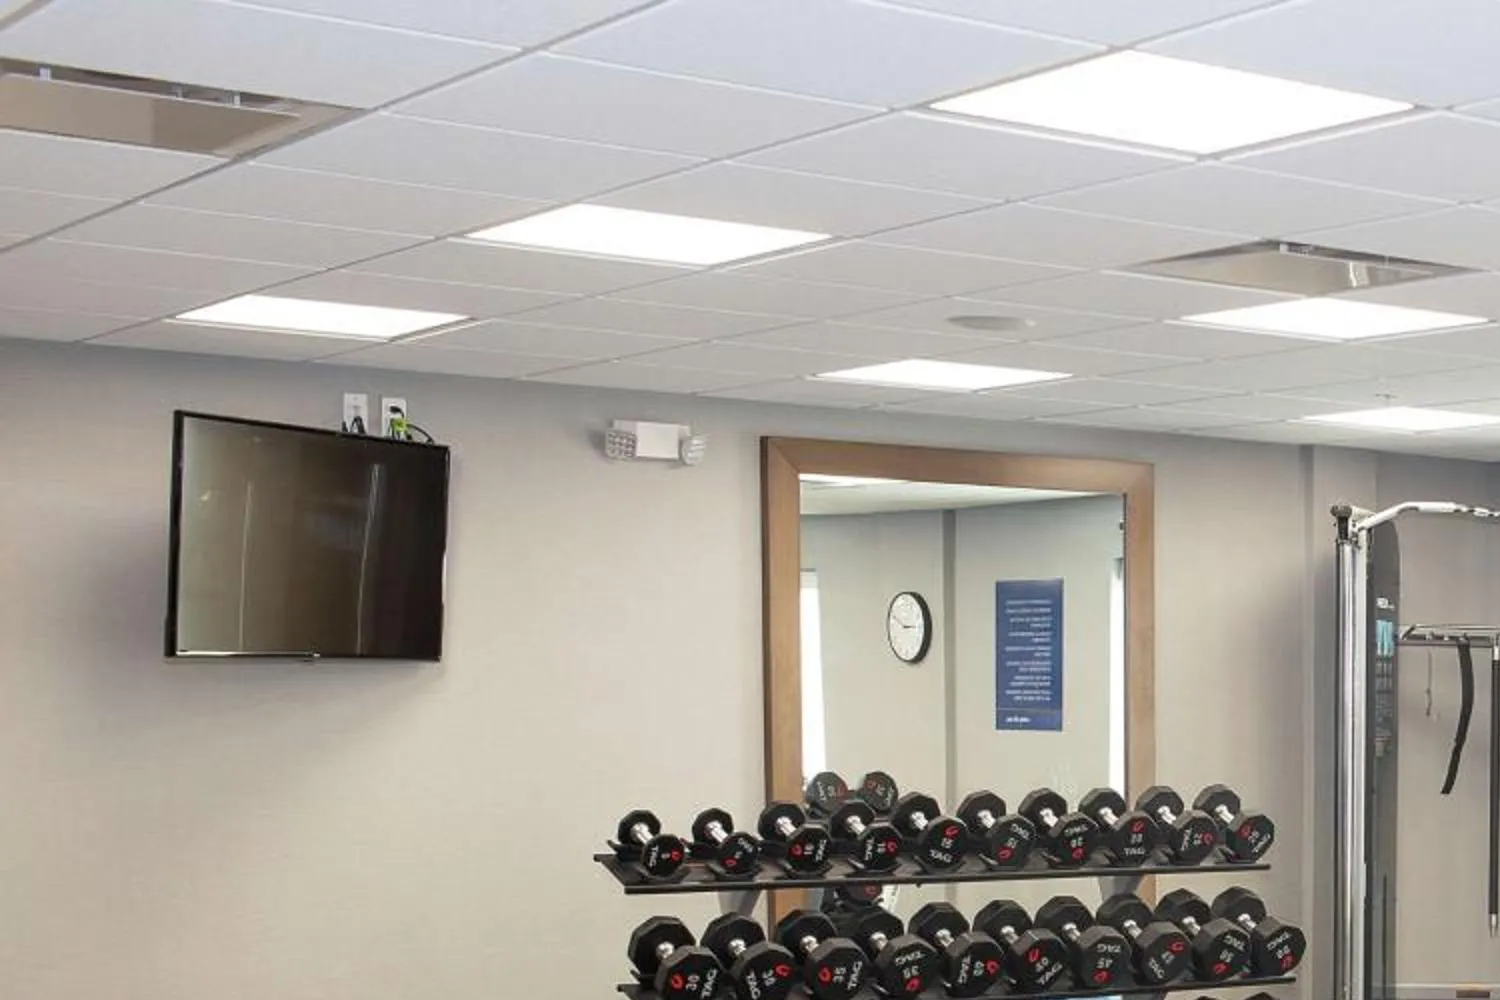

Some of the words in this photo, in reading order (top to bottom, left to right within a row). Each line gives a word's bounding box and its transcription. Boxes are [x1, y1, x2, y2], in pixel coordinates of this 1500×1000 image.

[1096, 943, 1120, 953] TAG
[1223, 934, 1245, 951] TAG
[1266, 932, 1290, 951] TAG
[895, 950, 926, 966] TAG
[1148, 957, 1165, 979] TAG
[847, 961, 863, 991] TAG
[958, 955, 971, 984] TAG
[1036, 962, 1062, 985] TAG
[701, 968, 718, 999] TAG
[745, 971, 761, 1000] TAG
